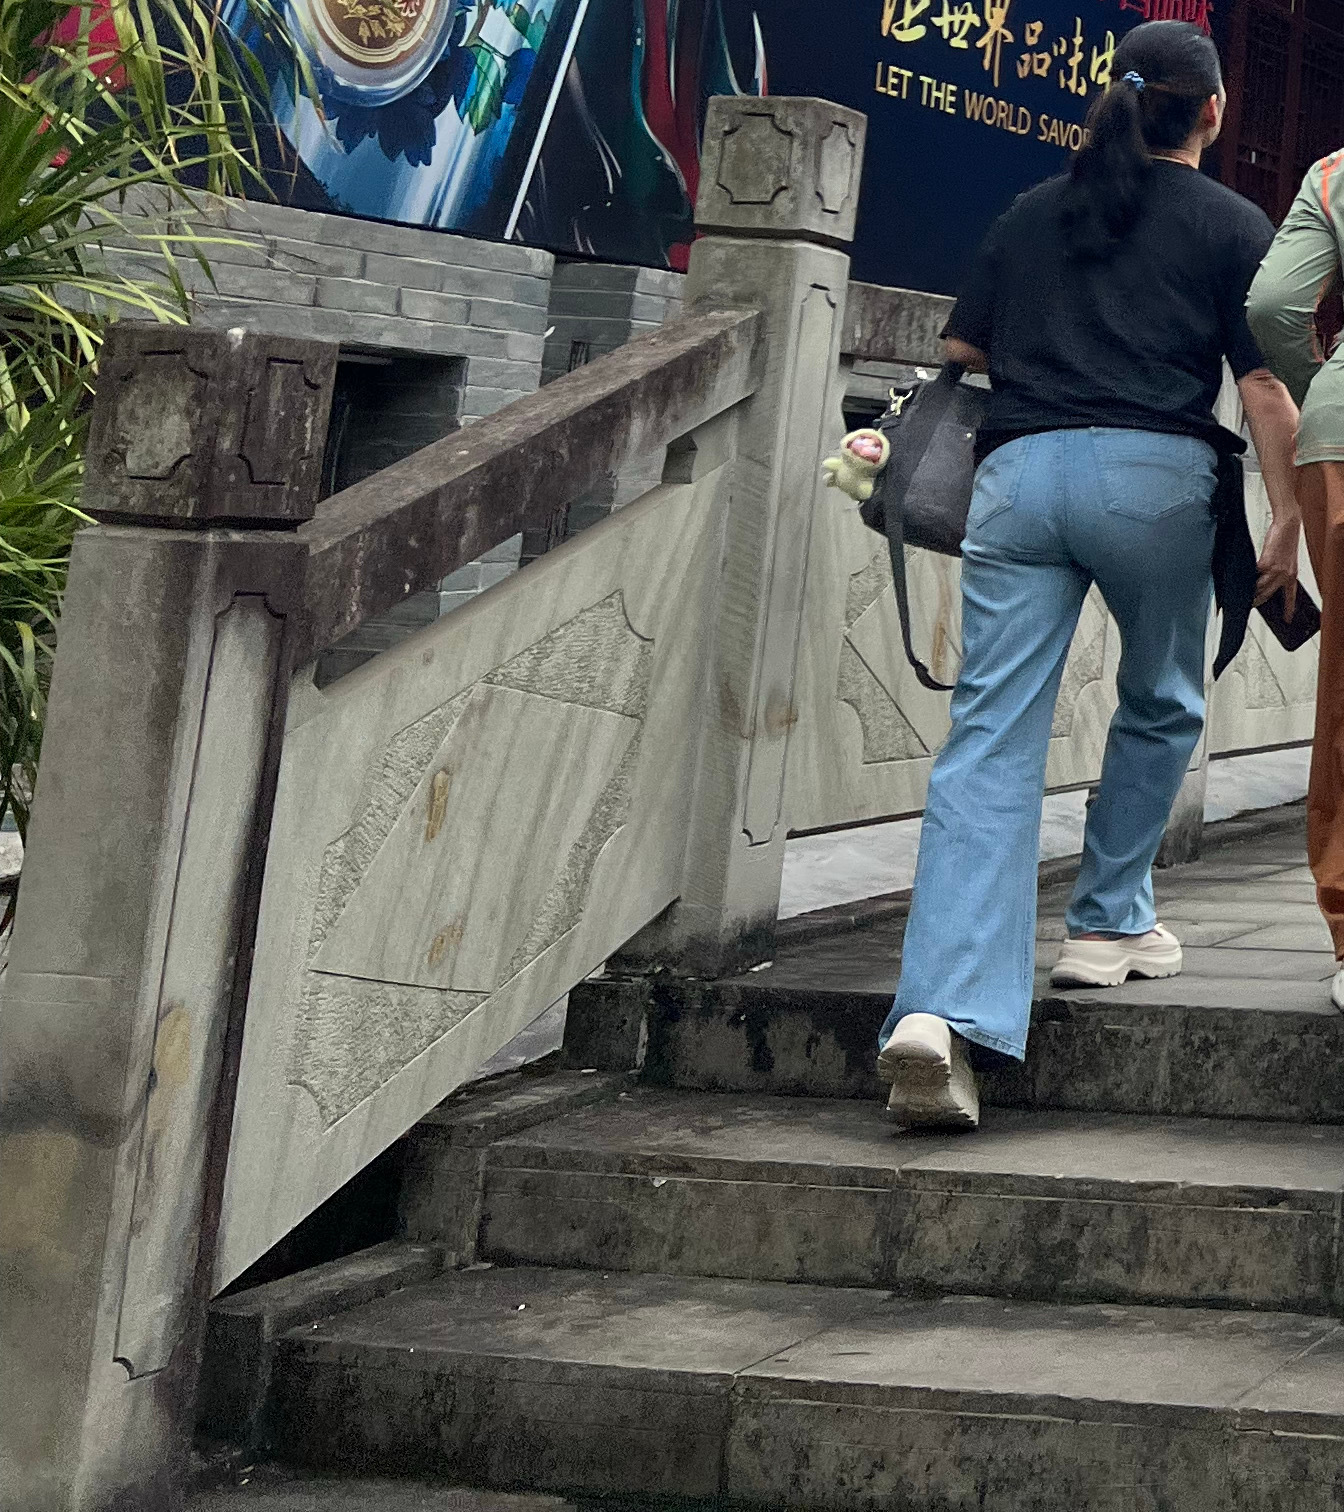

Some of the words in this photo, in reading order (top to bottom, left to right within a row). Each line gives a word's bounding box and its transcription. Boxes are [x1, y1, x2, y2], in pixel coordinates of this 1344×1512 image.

[875, 61, 914, 99] LET
[919, 75, 958, 115] THE
[964, 89, 1032, 135] WORLD
